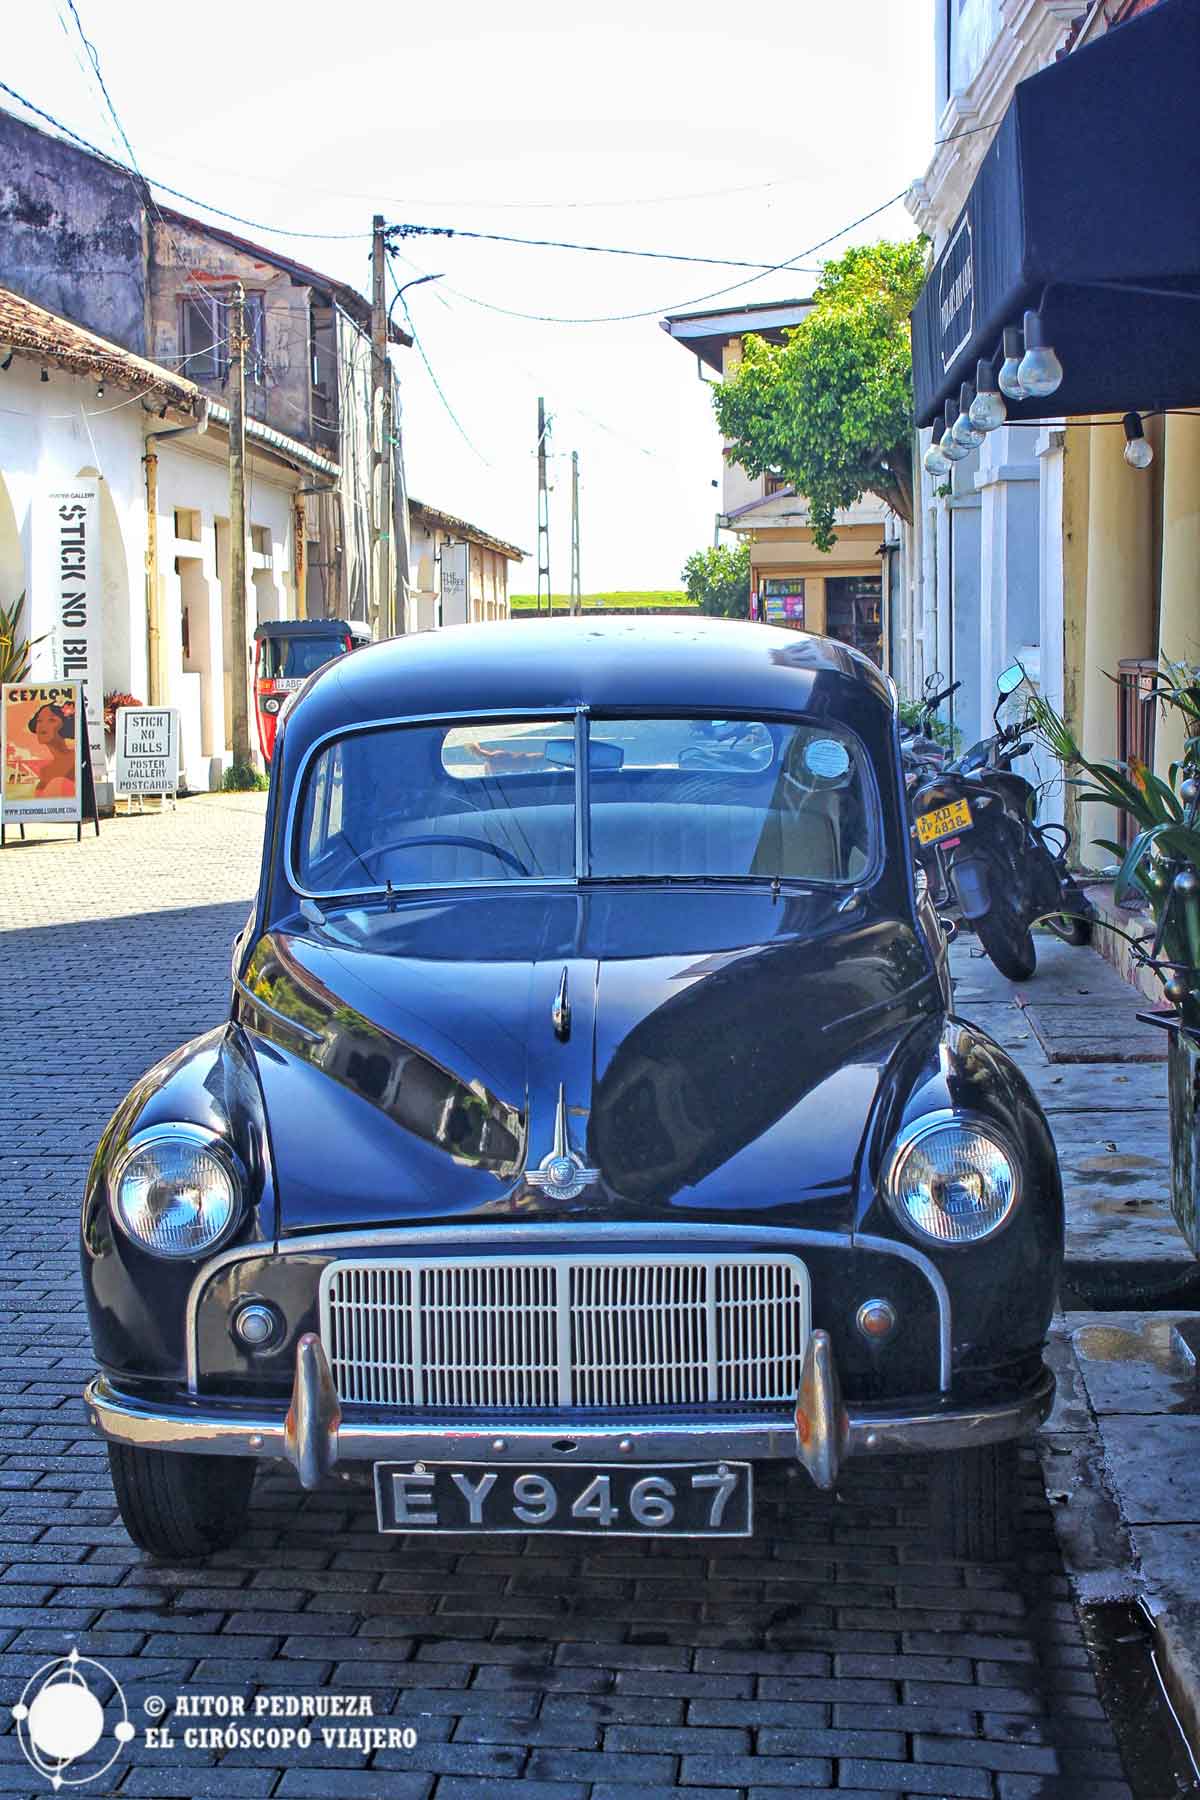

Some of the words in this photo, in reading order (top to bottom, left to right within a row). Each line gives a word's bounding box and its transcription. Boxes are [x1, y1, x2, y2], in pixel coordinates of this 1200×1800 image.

[59, 505, 86, 580] STICK
[62, 593, 86, 627] NO
[9, 688, 73, 701] CEYLON
[131, 715, 163, 727] STICK
[141, 730, 154, 740] NO
[131, 742, 162, 753] BILLS
[130, 760, 165, 769] POSTER
[127, 769, 167, 779] GALLERY
[120, 781, 174, 790] POSTCARDS
